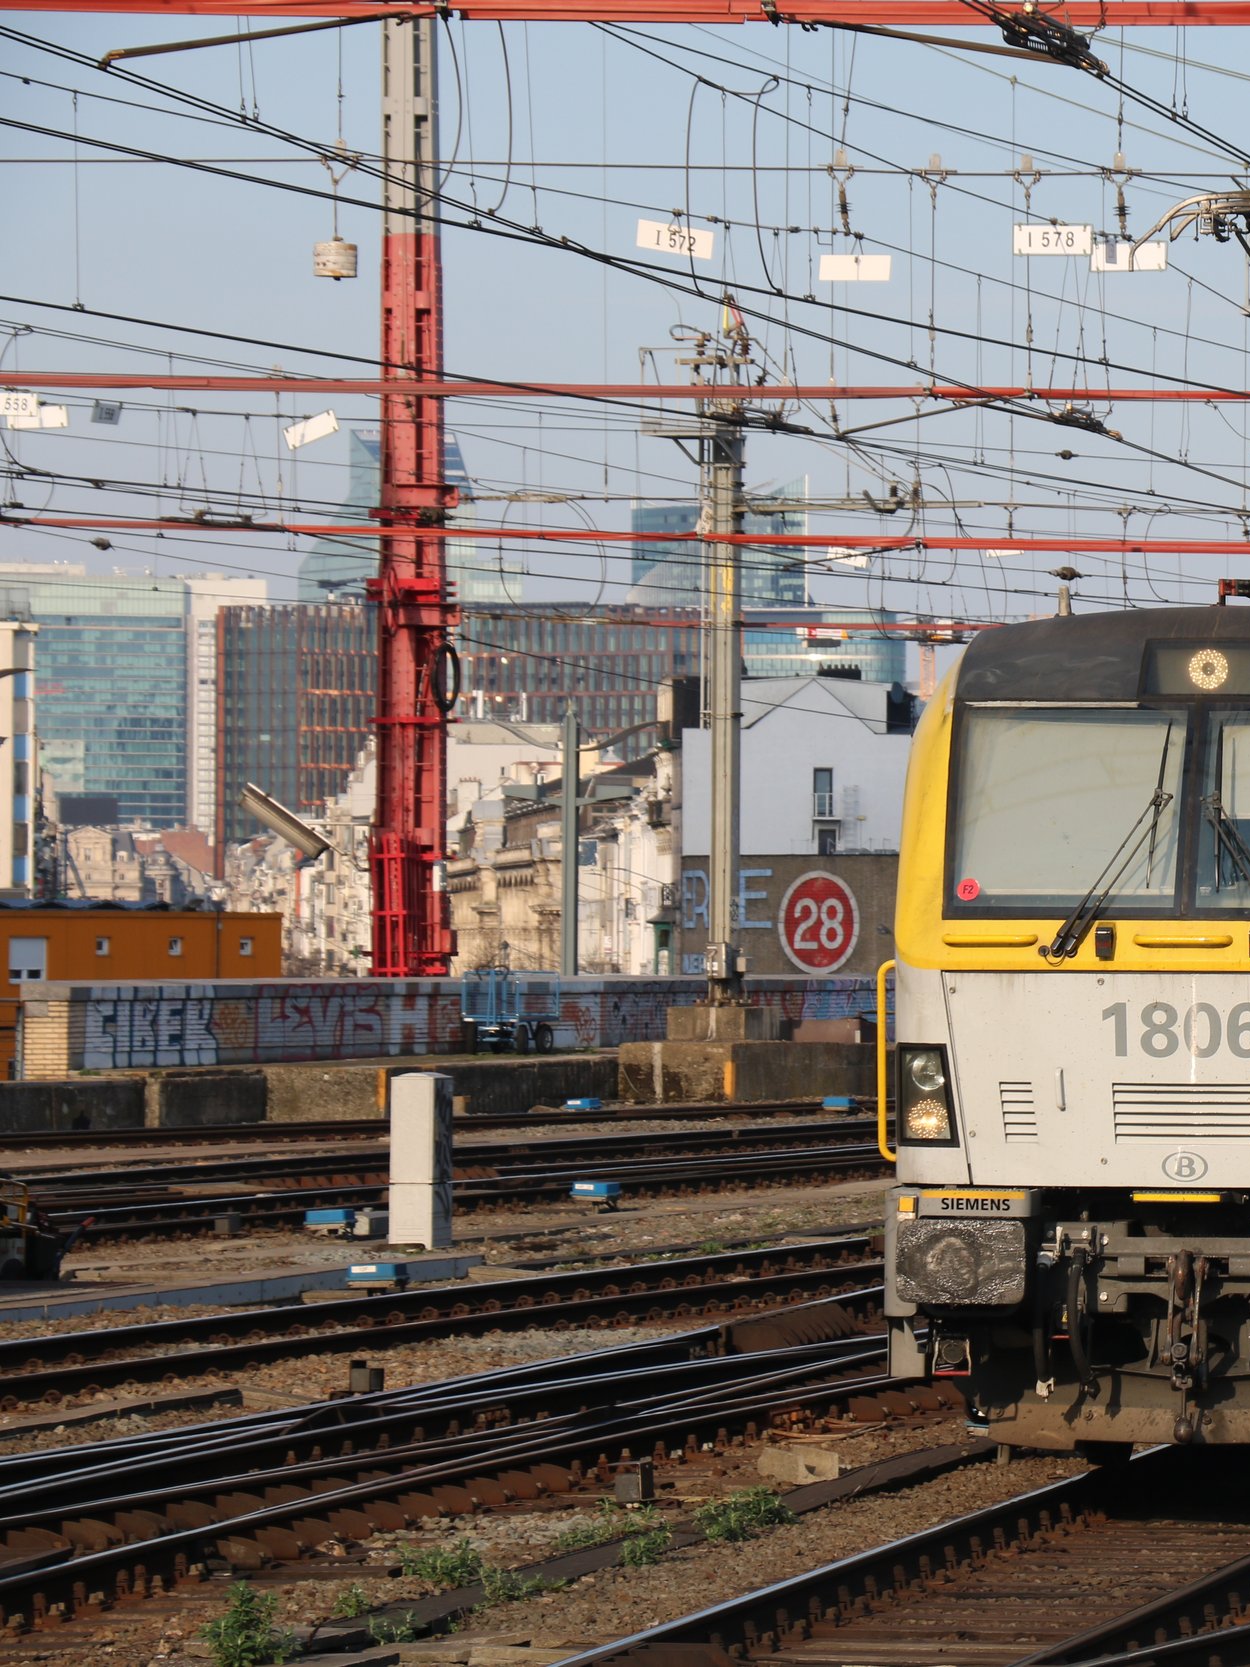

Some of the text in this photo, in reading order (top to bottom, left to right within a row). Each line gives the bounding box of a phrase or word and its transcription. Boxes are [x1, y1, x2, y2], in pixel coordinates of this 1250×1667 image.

[668, 231, 696, 252] 572
[1041, 231, 1075, 248] 578
[962, 884, 974, 895] F2
[793, 897, 845, 950] 28
[941, 1197, 1011, 1211] SIEMENS
